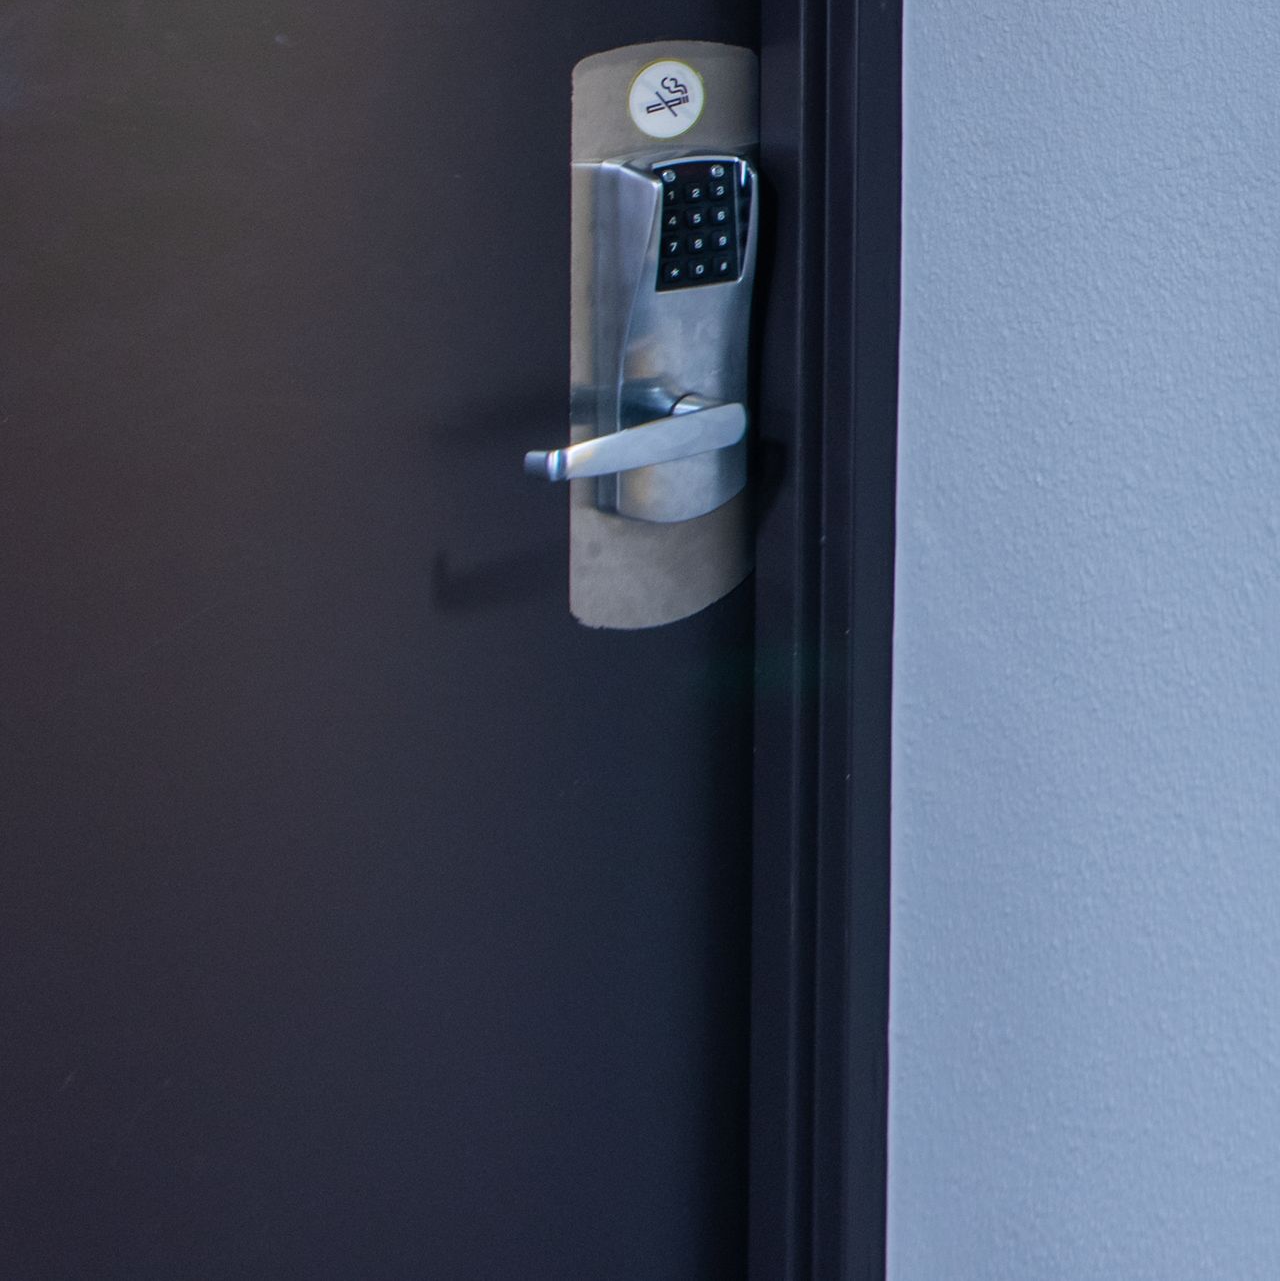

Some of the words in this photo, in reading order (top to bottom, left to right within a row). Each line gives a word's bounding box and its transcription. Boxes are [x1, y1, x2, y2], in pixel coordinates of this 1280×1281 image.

[668, 190, 675, 200] 1
[691, 188, 701, 198] 2
[716, 185, 725, 196] 3
[668, 215, 677, 225] 4
[693, 213, 702, 223] 5
[717, 211, 726, 221] 6
[669, 241, 678, 252] 7
[694, 238, 703, 249] 8
[719, 236, 728, 246] 9
[695, 264, 704, 275] 0
